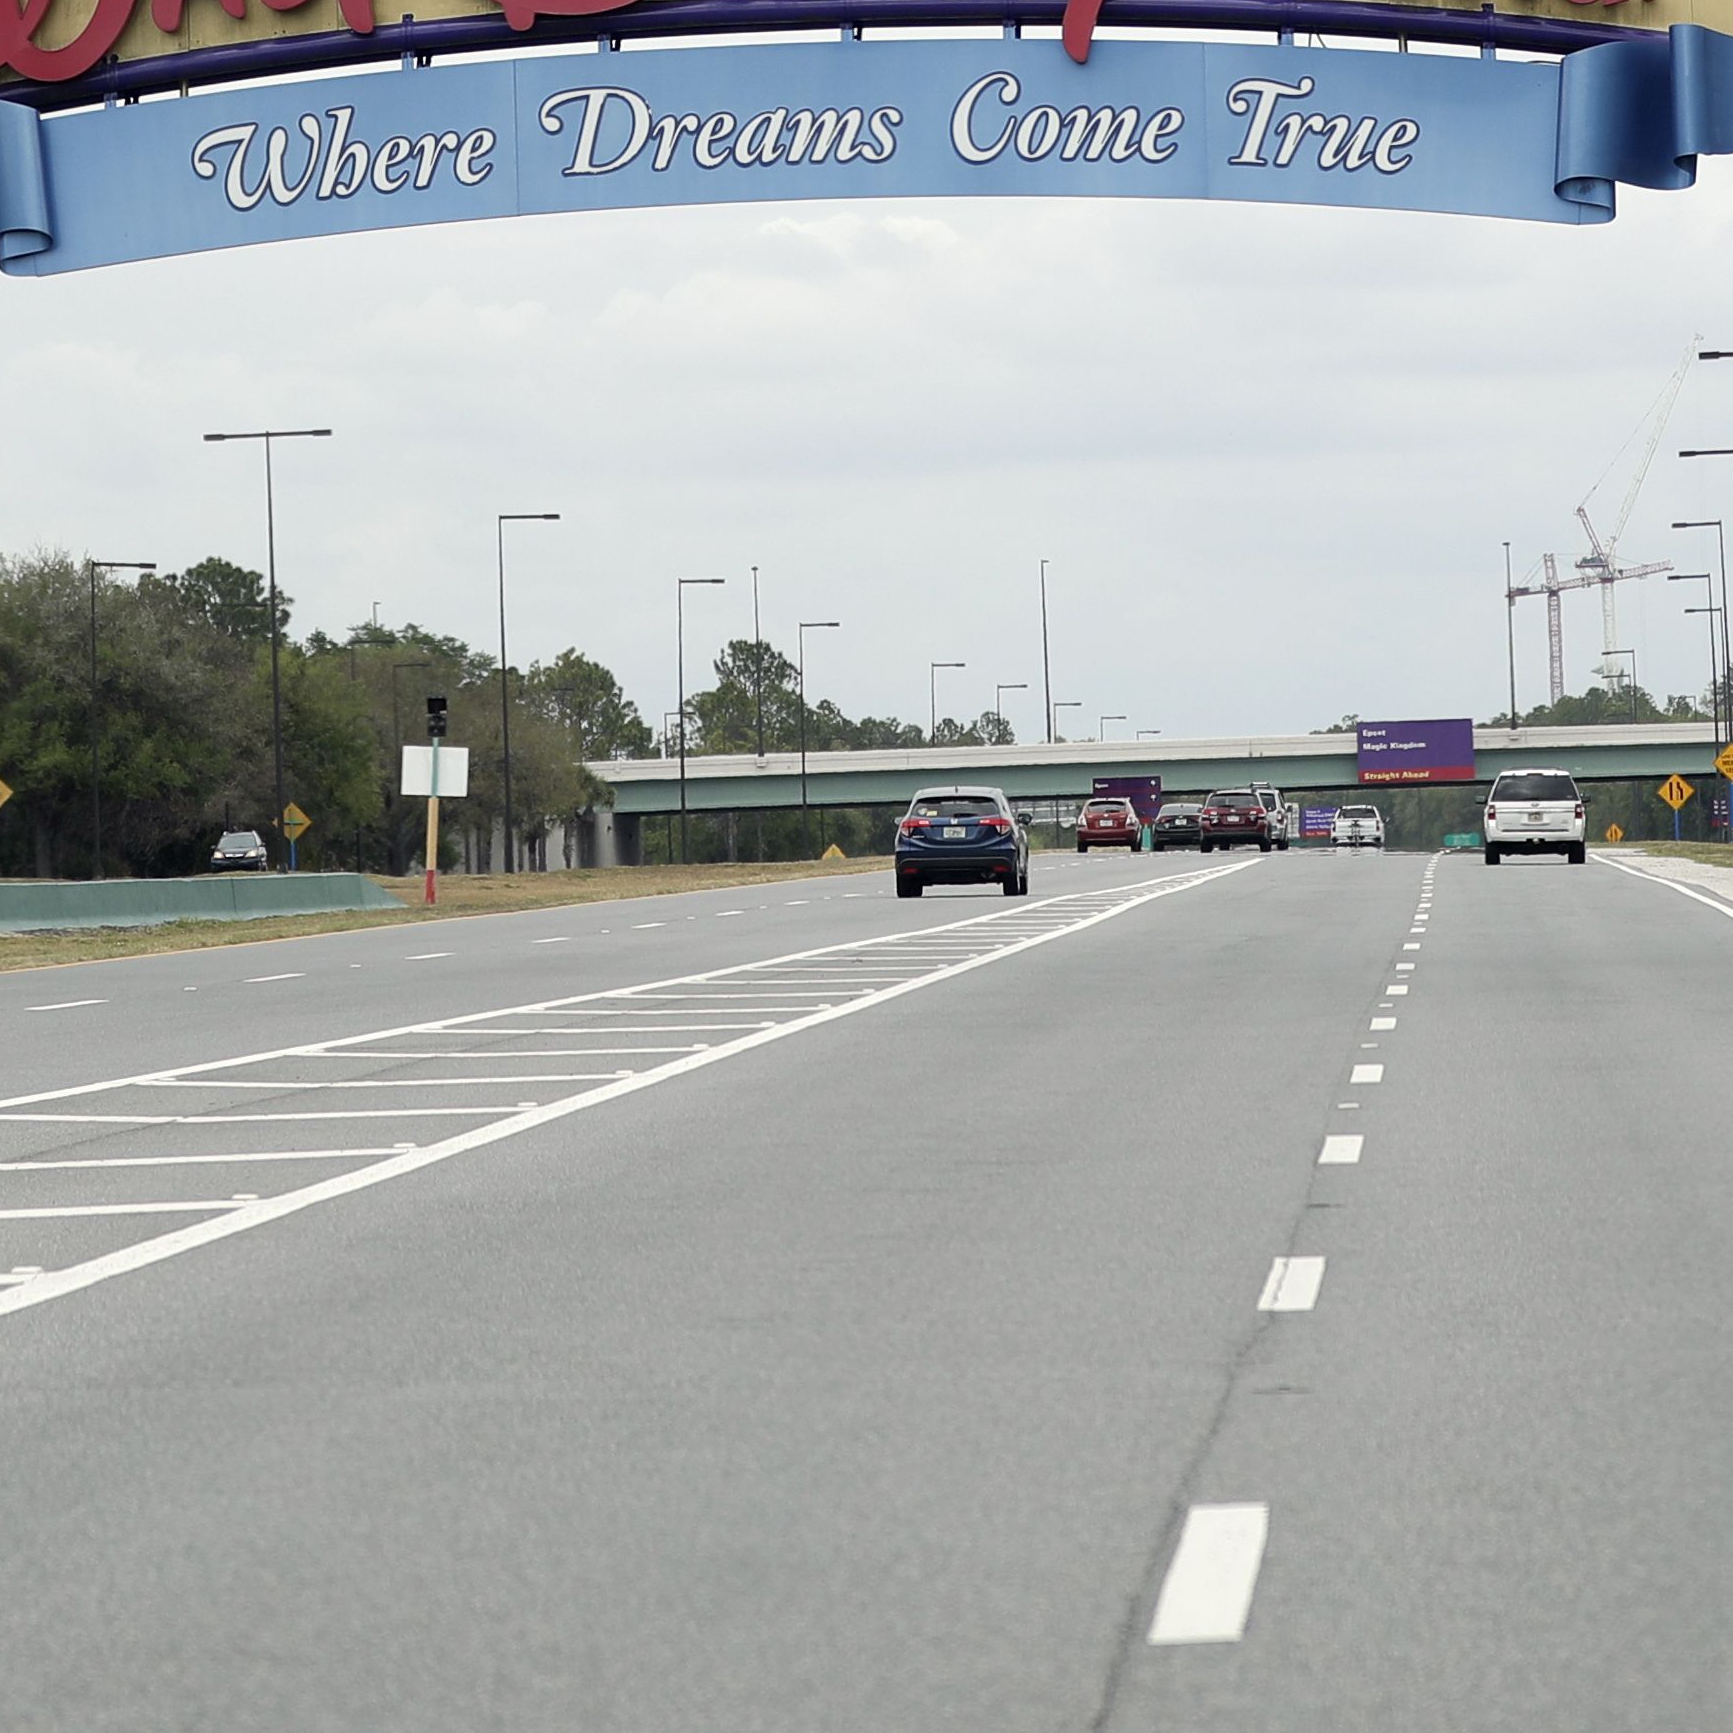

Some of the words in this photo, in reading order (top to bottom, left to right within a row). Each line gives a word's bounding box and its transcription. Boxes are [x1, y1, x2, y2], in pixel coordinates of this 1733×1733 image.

[192, 106, 497, 213] Where
[538, 86, 903, 176] Dreams
[950, 70, 1185, 165] Come
[1227, 76, 1420, 175] True
[1362, 729, 1386, 738] Epcot
[1362, 743, 1387, 751] Magic
[1389, 742, 1426, 750] Kingdom
[1364, 771, 1400, 781] Straight
[1401, 771, 1430, 779] Ahead
